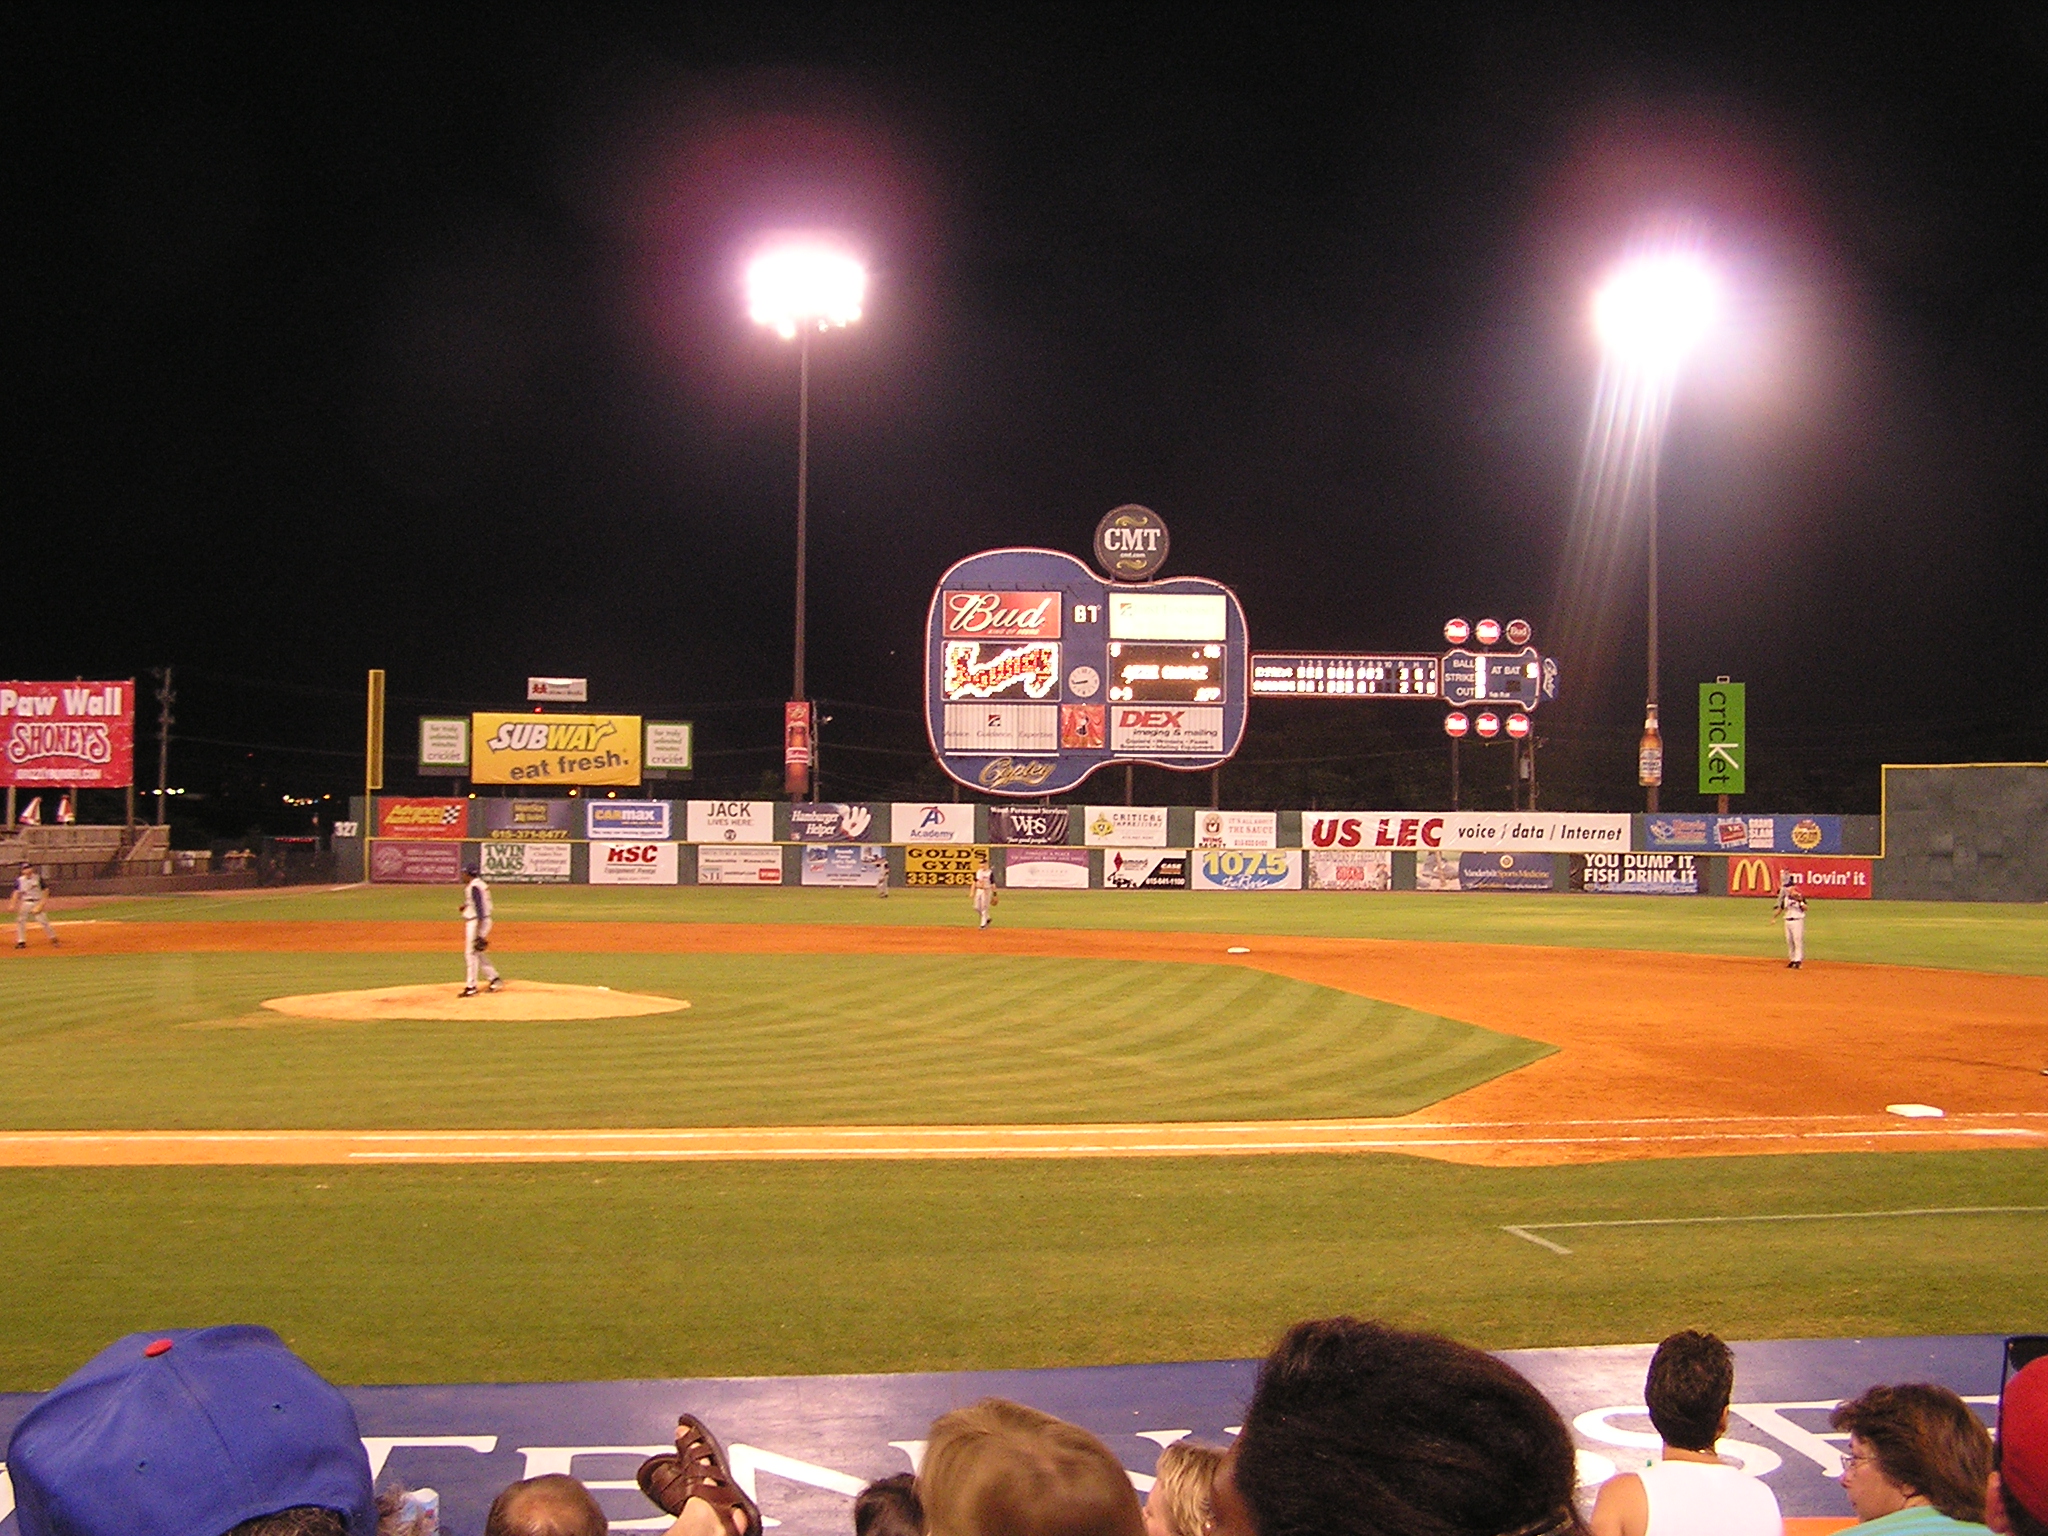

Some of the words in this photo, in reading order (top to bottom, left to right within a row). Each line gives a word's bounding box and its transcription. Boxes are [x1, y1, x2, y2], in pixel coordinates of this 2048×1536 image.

[1104, 528, 1161, 551] CMT
[950, 594, 1052, 632] Bud
[1453, 660, 1474, 668] BALL
[1491, 666, 1502, 675] AT
[1504, 666, 1521, 675] BAT
[1445, 674, 1475, 682] STRIKE
[1456, 688, 1475, 696] OUT
[0, 689, 57, 716] Paw
[63, 687, 122, 716] Wall
[1119, 710, 1185, 728] DEX
[487, 721, 617, 754] SUBWAY
[1133, 729, 1170, 737] imaging
[1184, 729, 1218, 737] mailing
[1707, 691, 1740, 784] cricket
[10, 725, 110, 760] SHONEY'S
[510, 764, 549, 781] eat
[707, 802, 751, 817] JACK
[707, 818, 729, 826] LIVES
[792, 810, 839, 824] Hamburger
[1113, 813, 1162, 822] CRITICAL
[335, 822, 358, 837] 327
[806, 823, 836, 837] Helper
[1010, 815, 1047, 836] WPS
[910, 829, 954, 839] Academy
[1312, 818, 1362, 848] US
[1374, 818, 1444, 848] LEC
[1458, 824, 1494, 840] voice
[1512, 824, 1544, 840] data
[1561, 826, 1622, 842] Internet
[484, 844, 525, 857] TWIN
[908, 848, 987, 859] GOLD'S
[486, 857, 524, 870] OAKS
[922, 861, 972, 870] GYM
[1204, 851, 1287, 876] 107.5
[1584, 853, 1620, 868] YOU
[1623, 854, 1674, 869] DUMP
[906, 872, 976, 886] 333-363
[1584, 869, 1620, 883] FISH
[1624, 869, 1676, 884] DRINK
[1680, 870, 1696, 883] IT
[1807, 871, 1849, 885] lovin'
[1853, 871, 1865, 884] it
